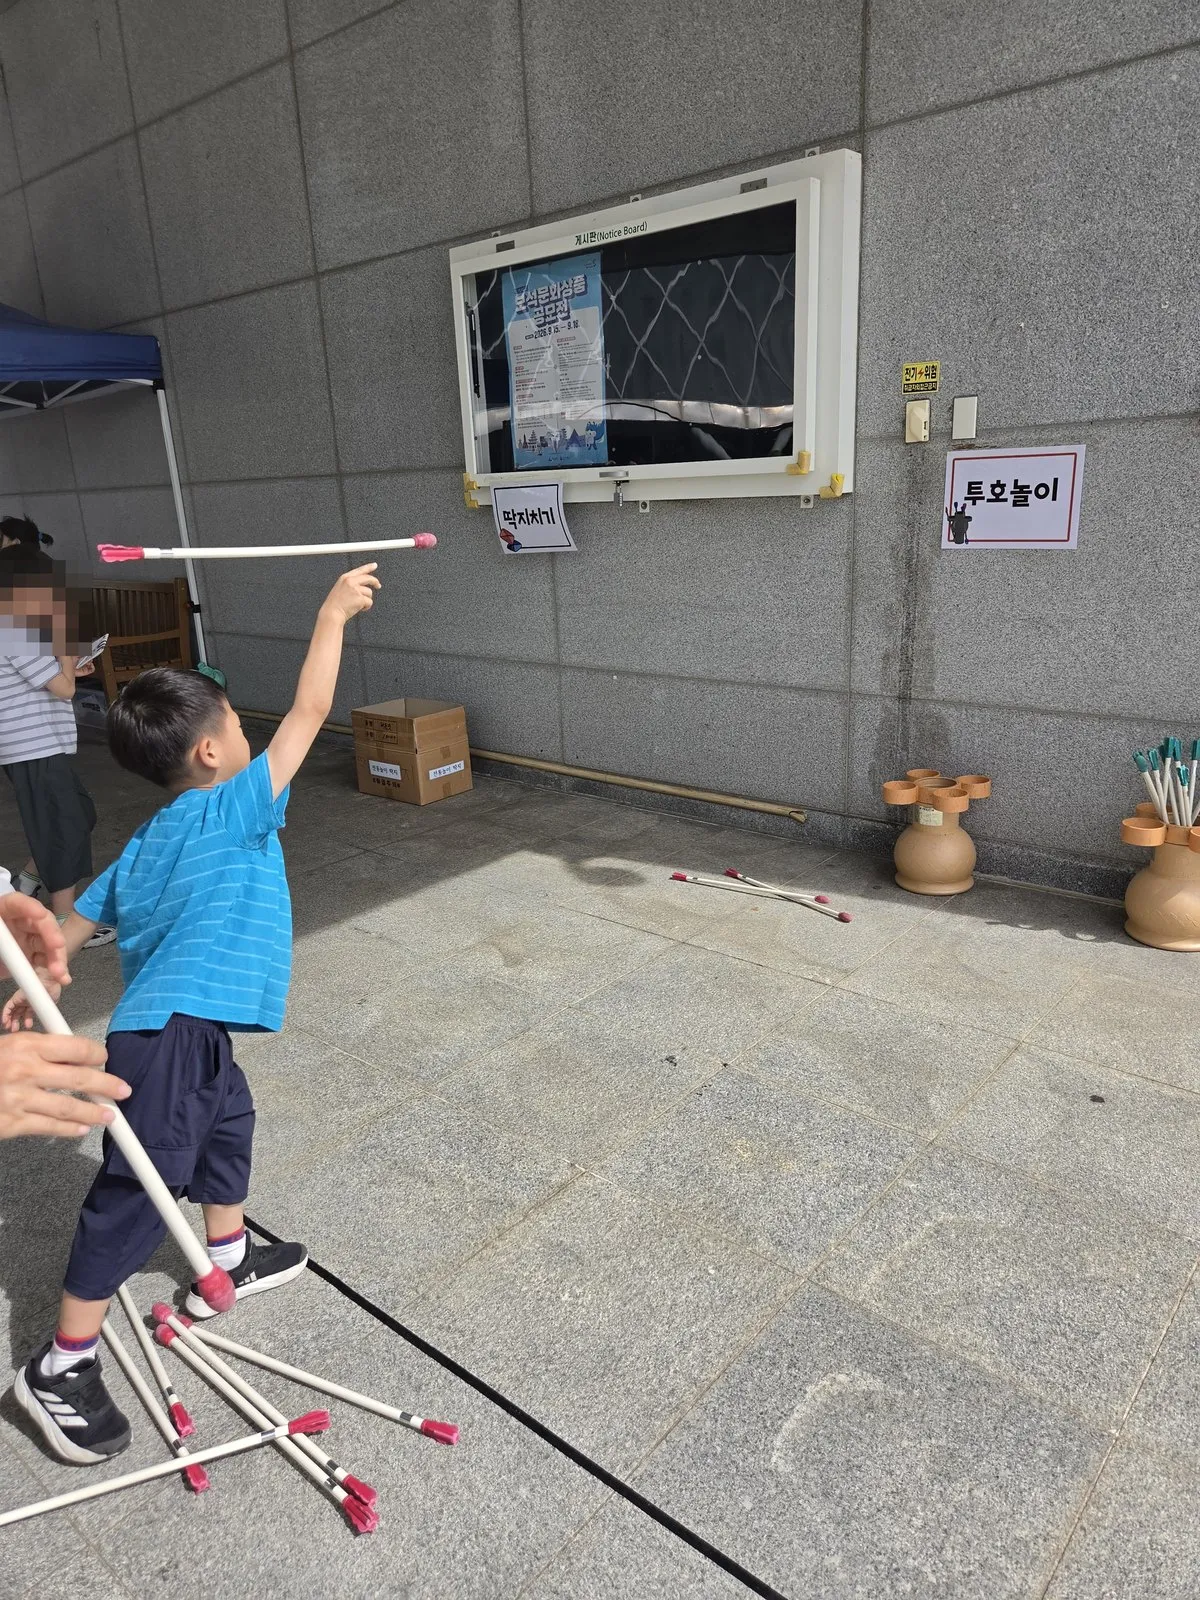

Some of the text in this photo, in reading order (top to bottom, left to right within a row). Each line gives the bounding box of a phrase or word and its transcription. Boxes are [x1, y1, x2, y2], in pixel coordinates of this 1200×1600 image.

[575, 221, 648, 246] 게시판(Notice Board)
[533, 299, 571, 328] 공모전
[904, 364, 938, 382] 전기 위험
[964, 477, 1059, 508] 투호놀이
[502, 506, 556, 530] 딱지치기
